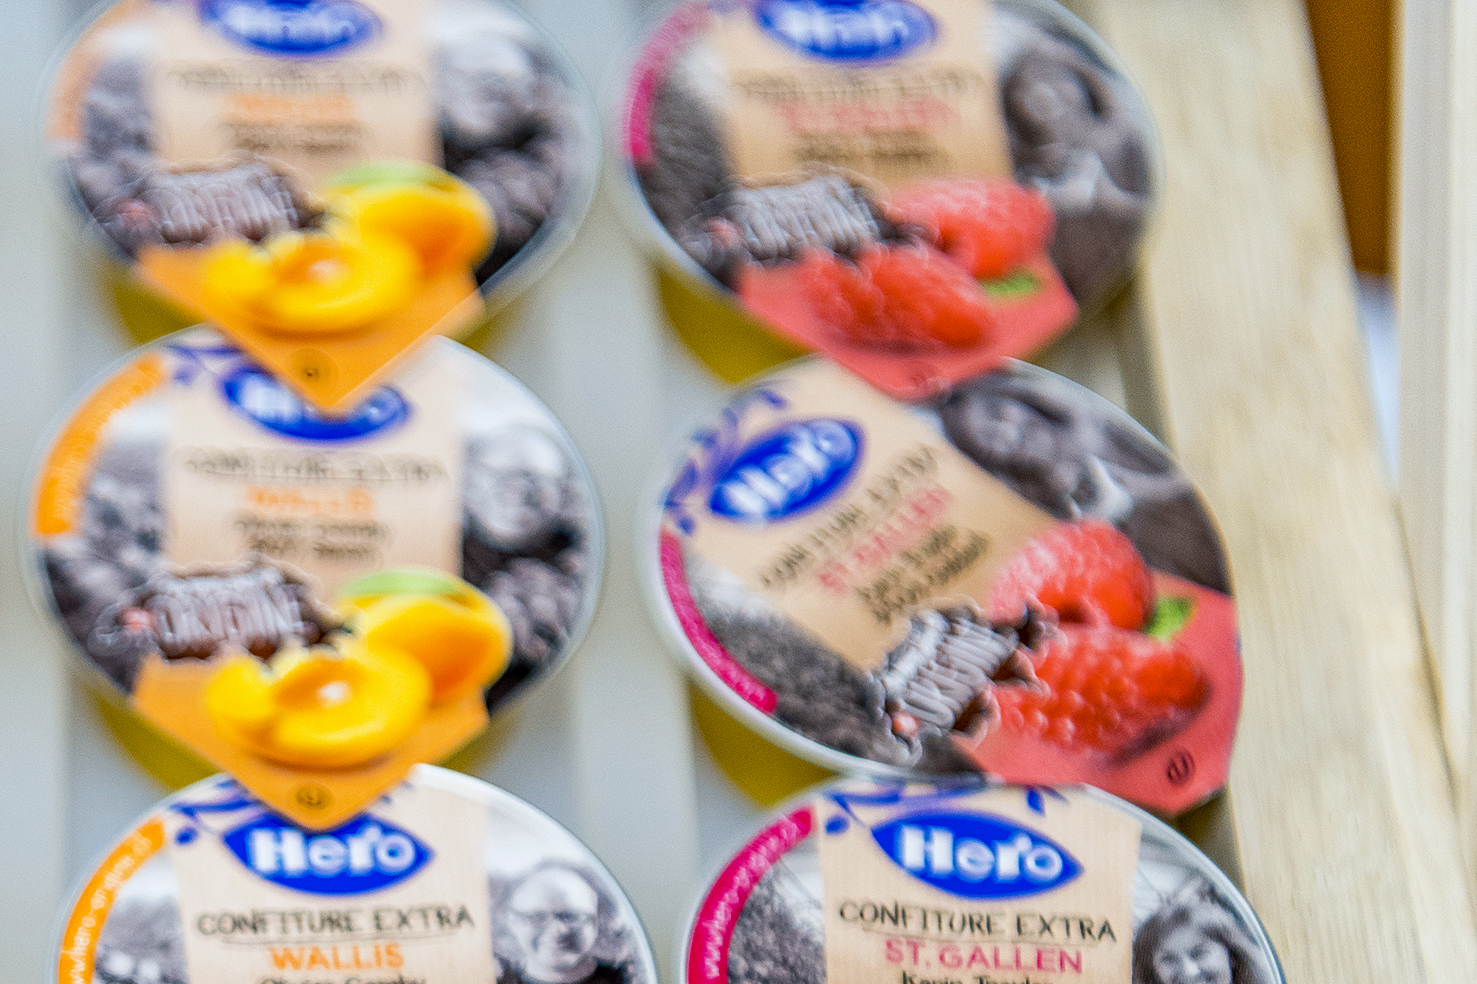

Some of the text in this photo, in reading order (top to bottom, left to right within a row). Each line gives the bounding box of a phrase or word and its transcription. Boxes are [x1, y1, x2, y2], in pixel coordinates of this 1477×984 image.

[246, 827, 415, 876] Hero
[899, 827, 1065, 883] Hero
[198, 906, 475, 936] CONFITURE EXTRA
[839, 901, 1116, 942] CONFITURE EXTRA
[270, 944, 404, 970] WALLIS
[938, 945, 1082, 973] GALLEN
